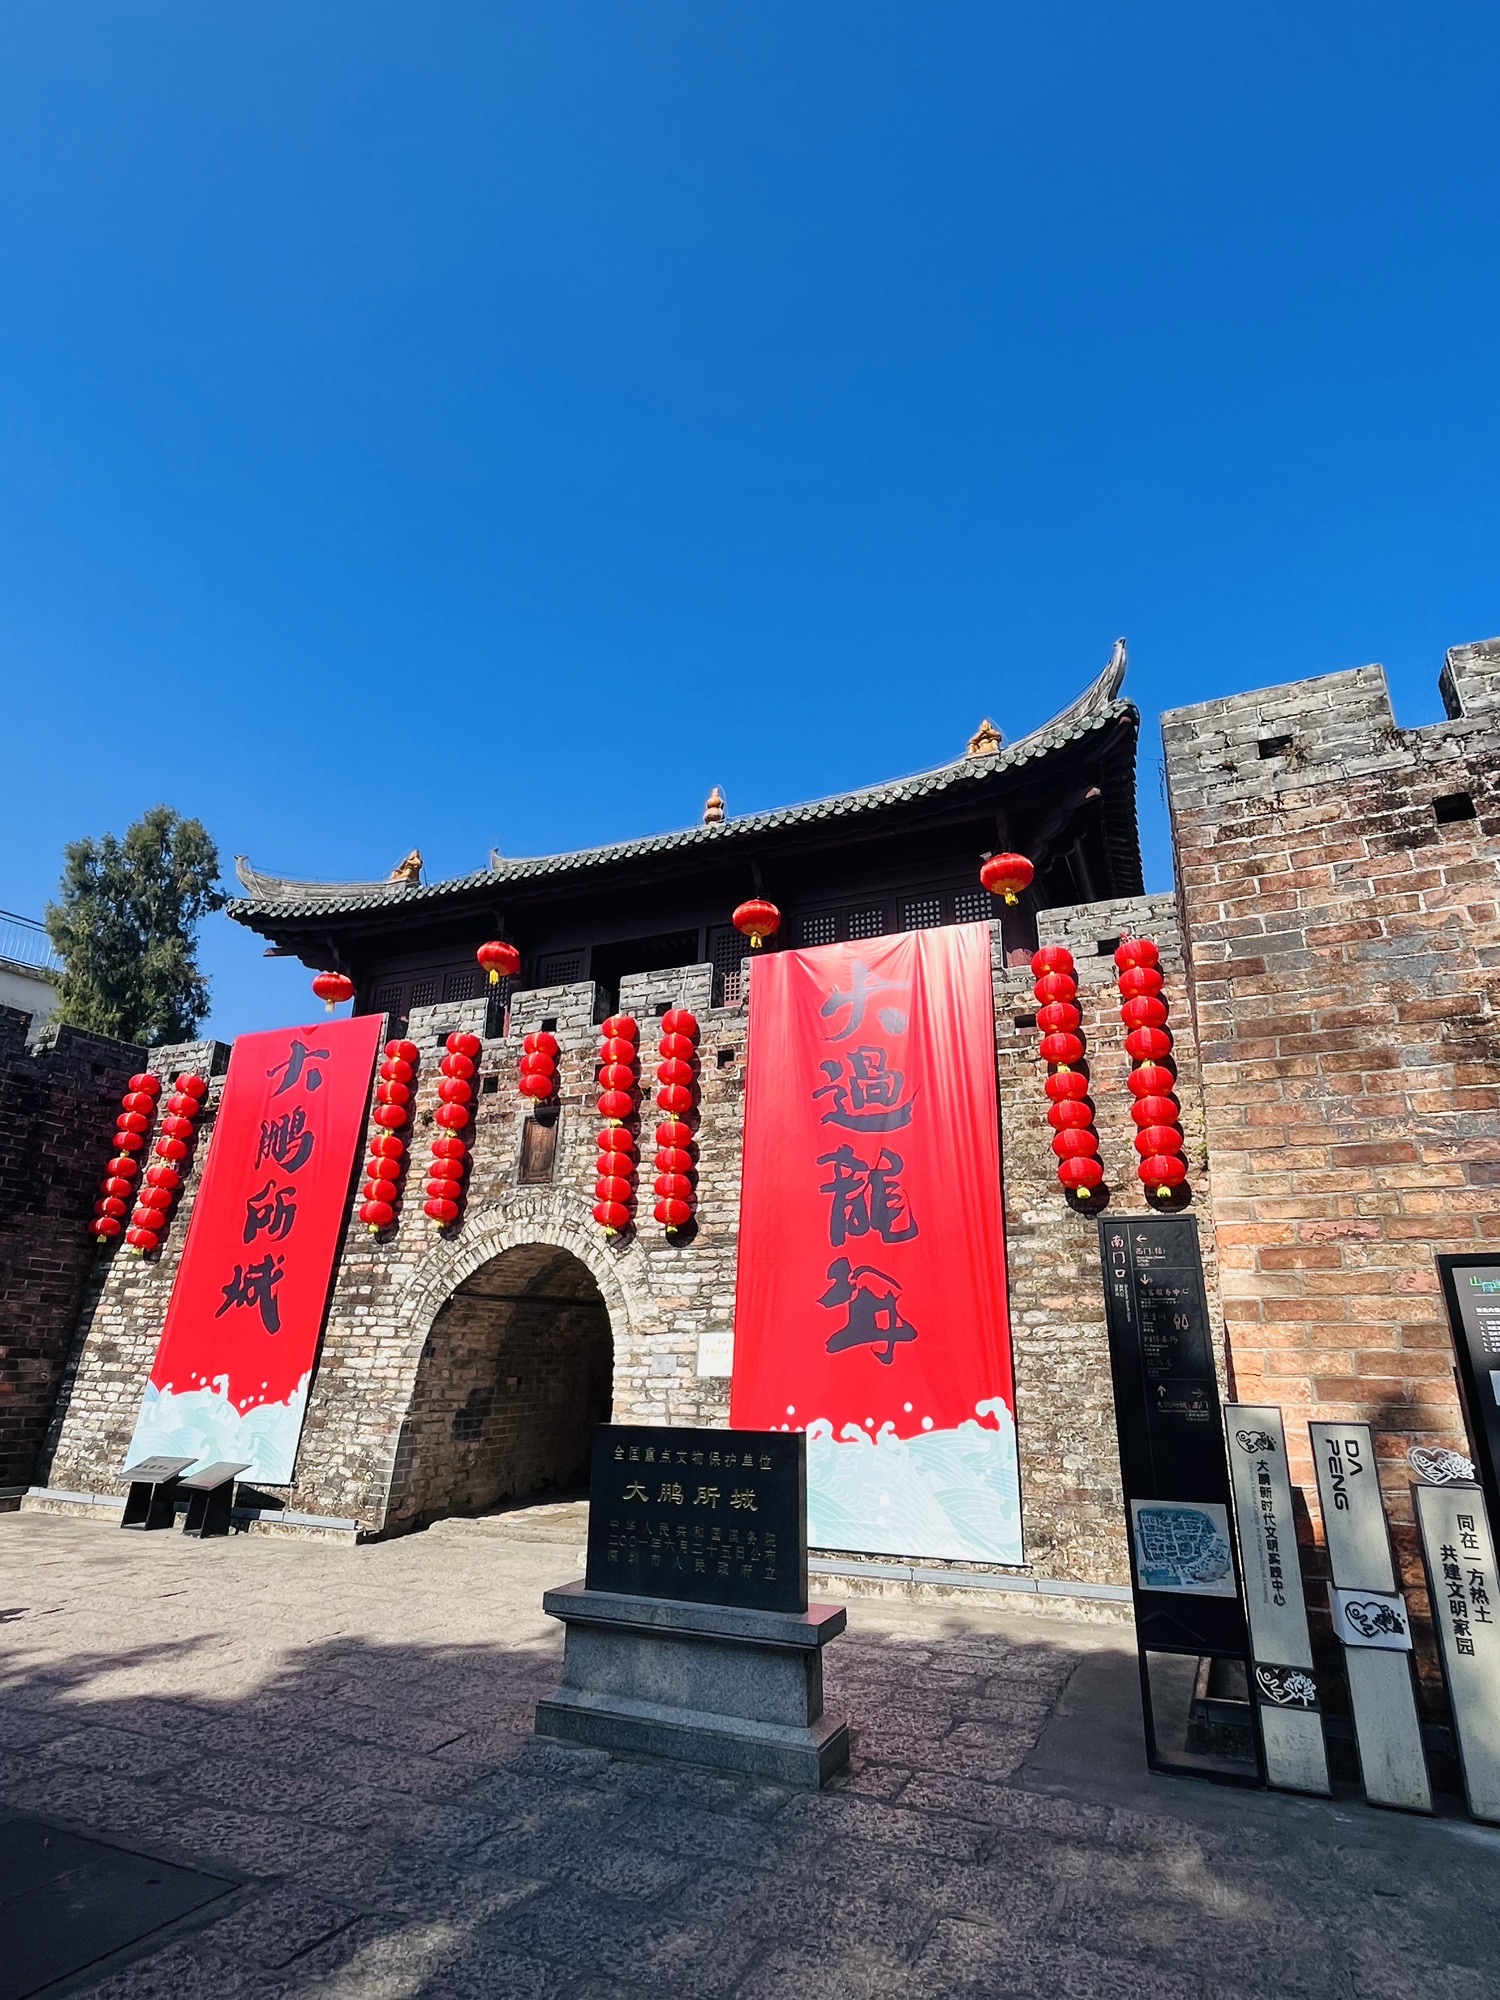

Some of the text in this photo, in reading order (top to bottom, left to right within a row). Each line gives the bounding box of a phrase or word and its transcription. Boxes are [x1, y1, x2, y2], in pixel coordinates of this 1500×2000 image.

[1110, 1234, 1127, 1278] 南门口
[613, 1444, 773, 1471] 全国重点文物保护单位
[1325, 1438, 1350, 1511] PENG
[622, 1480, 759, 1512] 大鹏所城
[609, 1517, 777, 1548] 中华人民共和国国务院
[607, 1550, 777, 1581] 深圳市人民政府立
[1456, 1513, 1494, 1625] 同在一方热土
[1439, 1543, 1476, 1657] 共建文明家园
